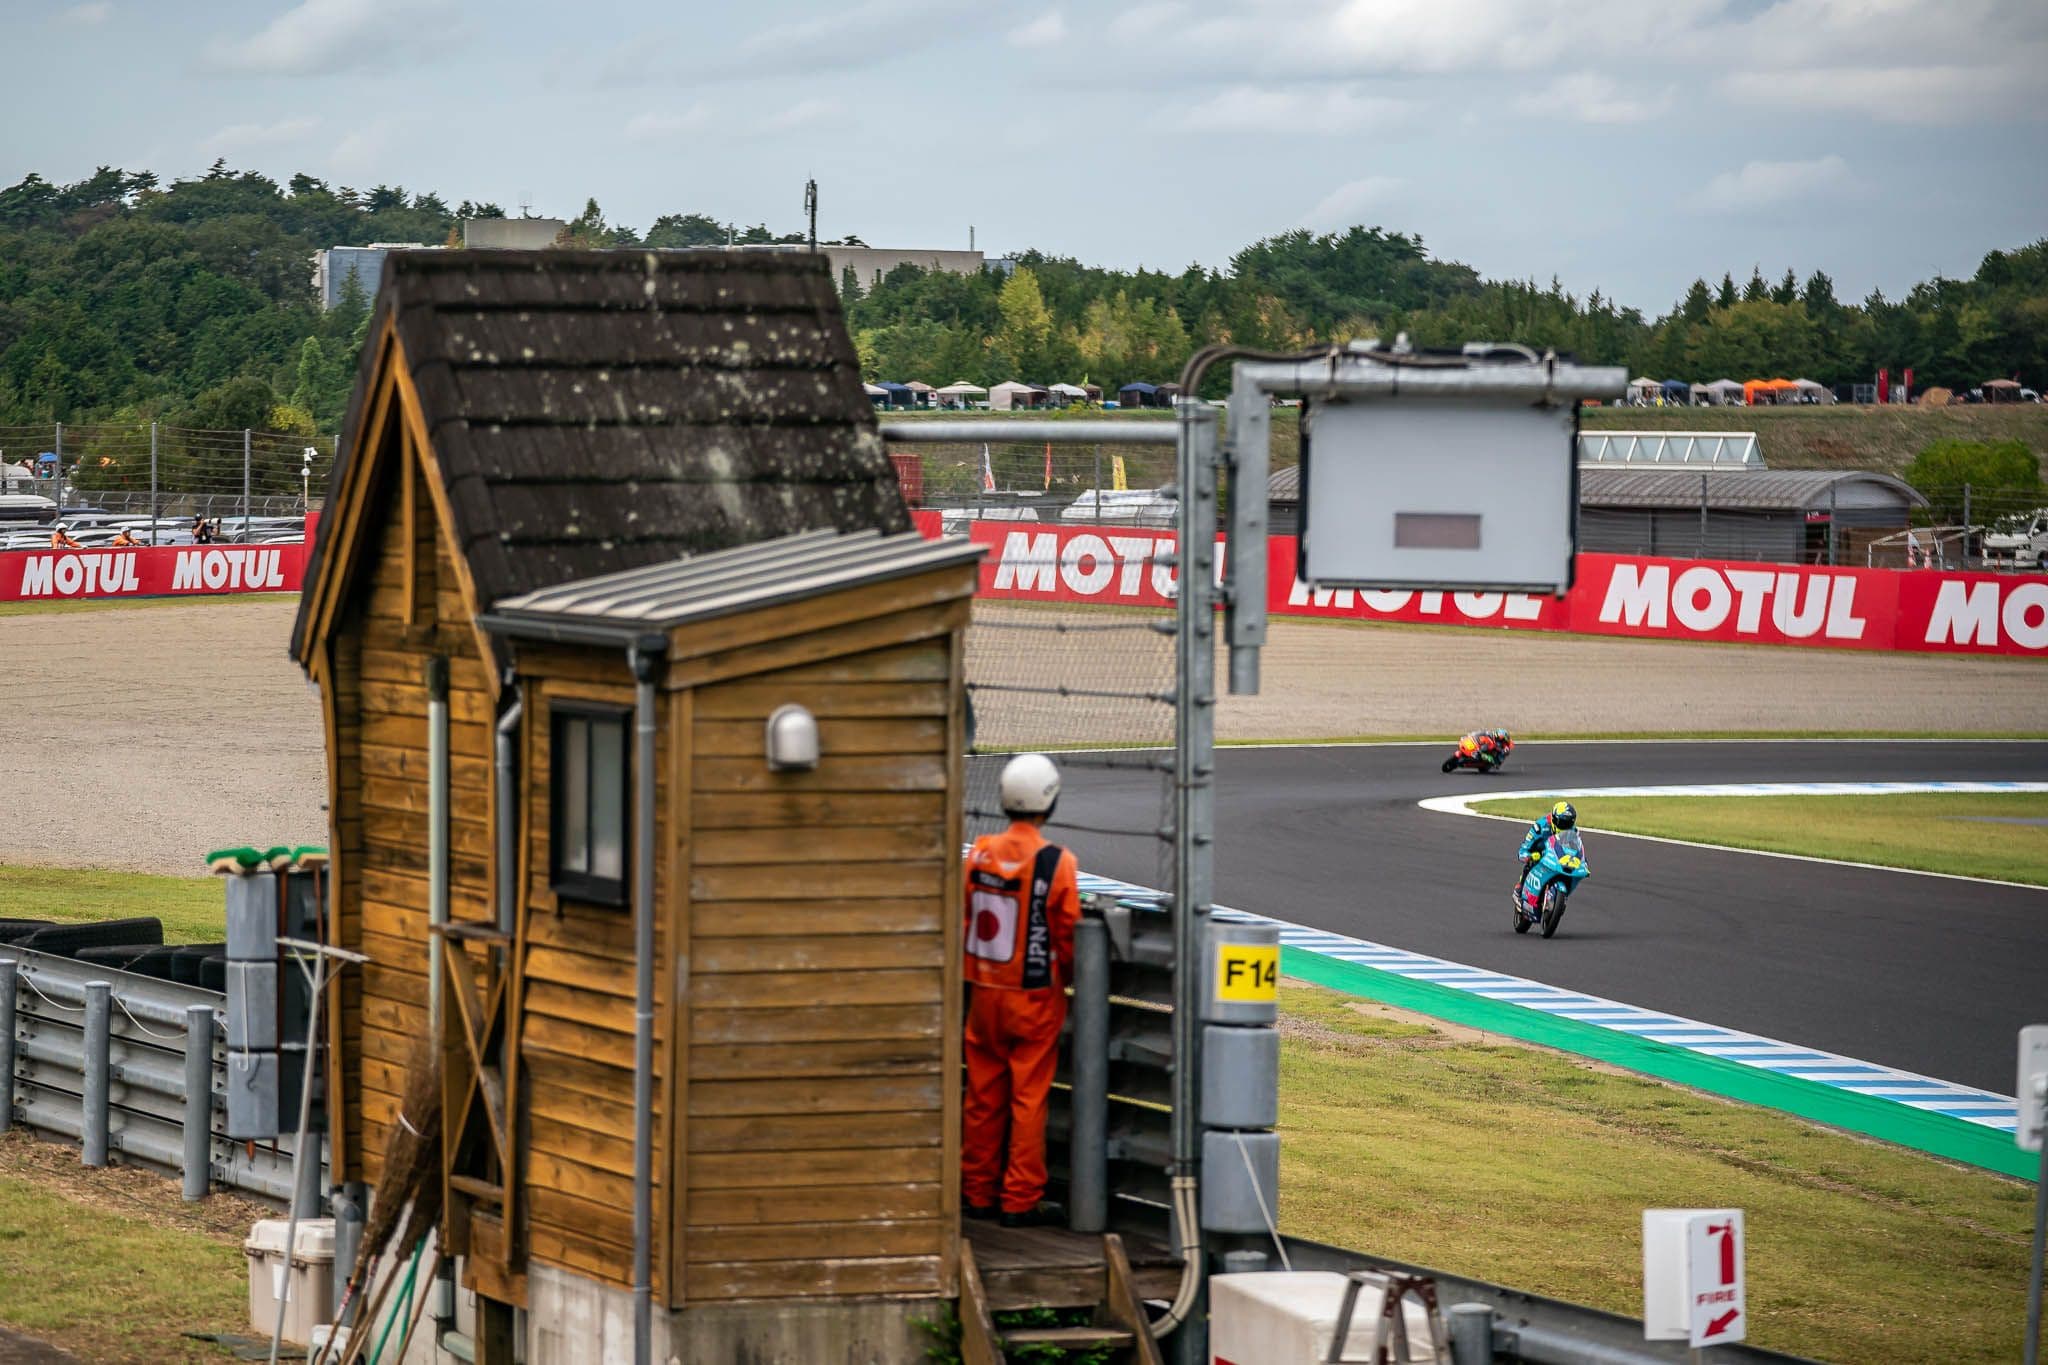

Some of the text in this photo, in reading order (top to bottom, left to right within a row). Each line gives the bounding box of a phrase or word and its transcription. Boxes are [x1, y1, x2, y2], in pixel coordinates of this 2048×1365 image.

[20, 552, 140, 595] MOTUL
[172, 549, 284, 590] MOTUL
[1599, 563, 1866, 640] MOTUL
[1226, 959, 1275, 988] F14
